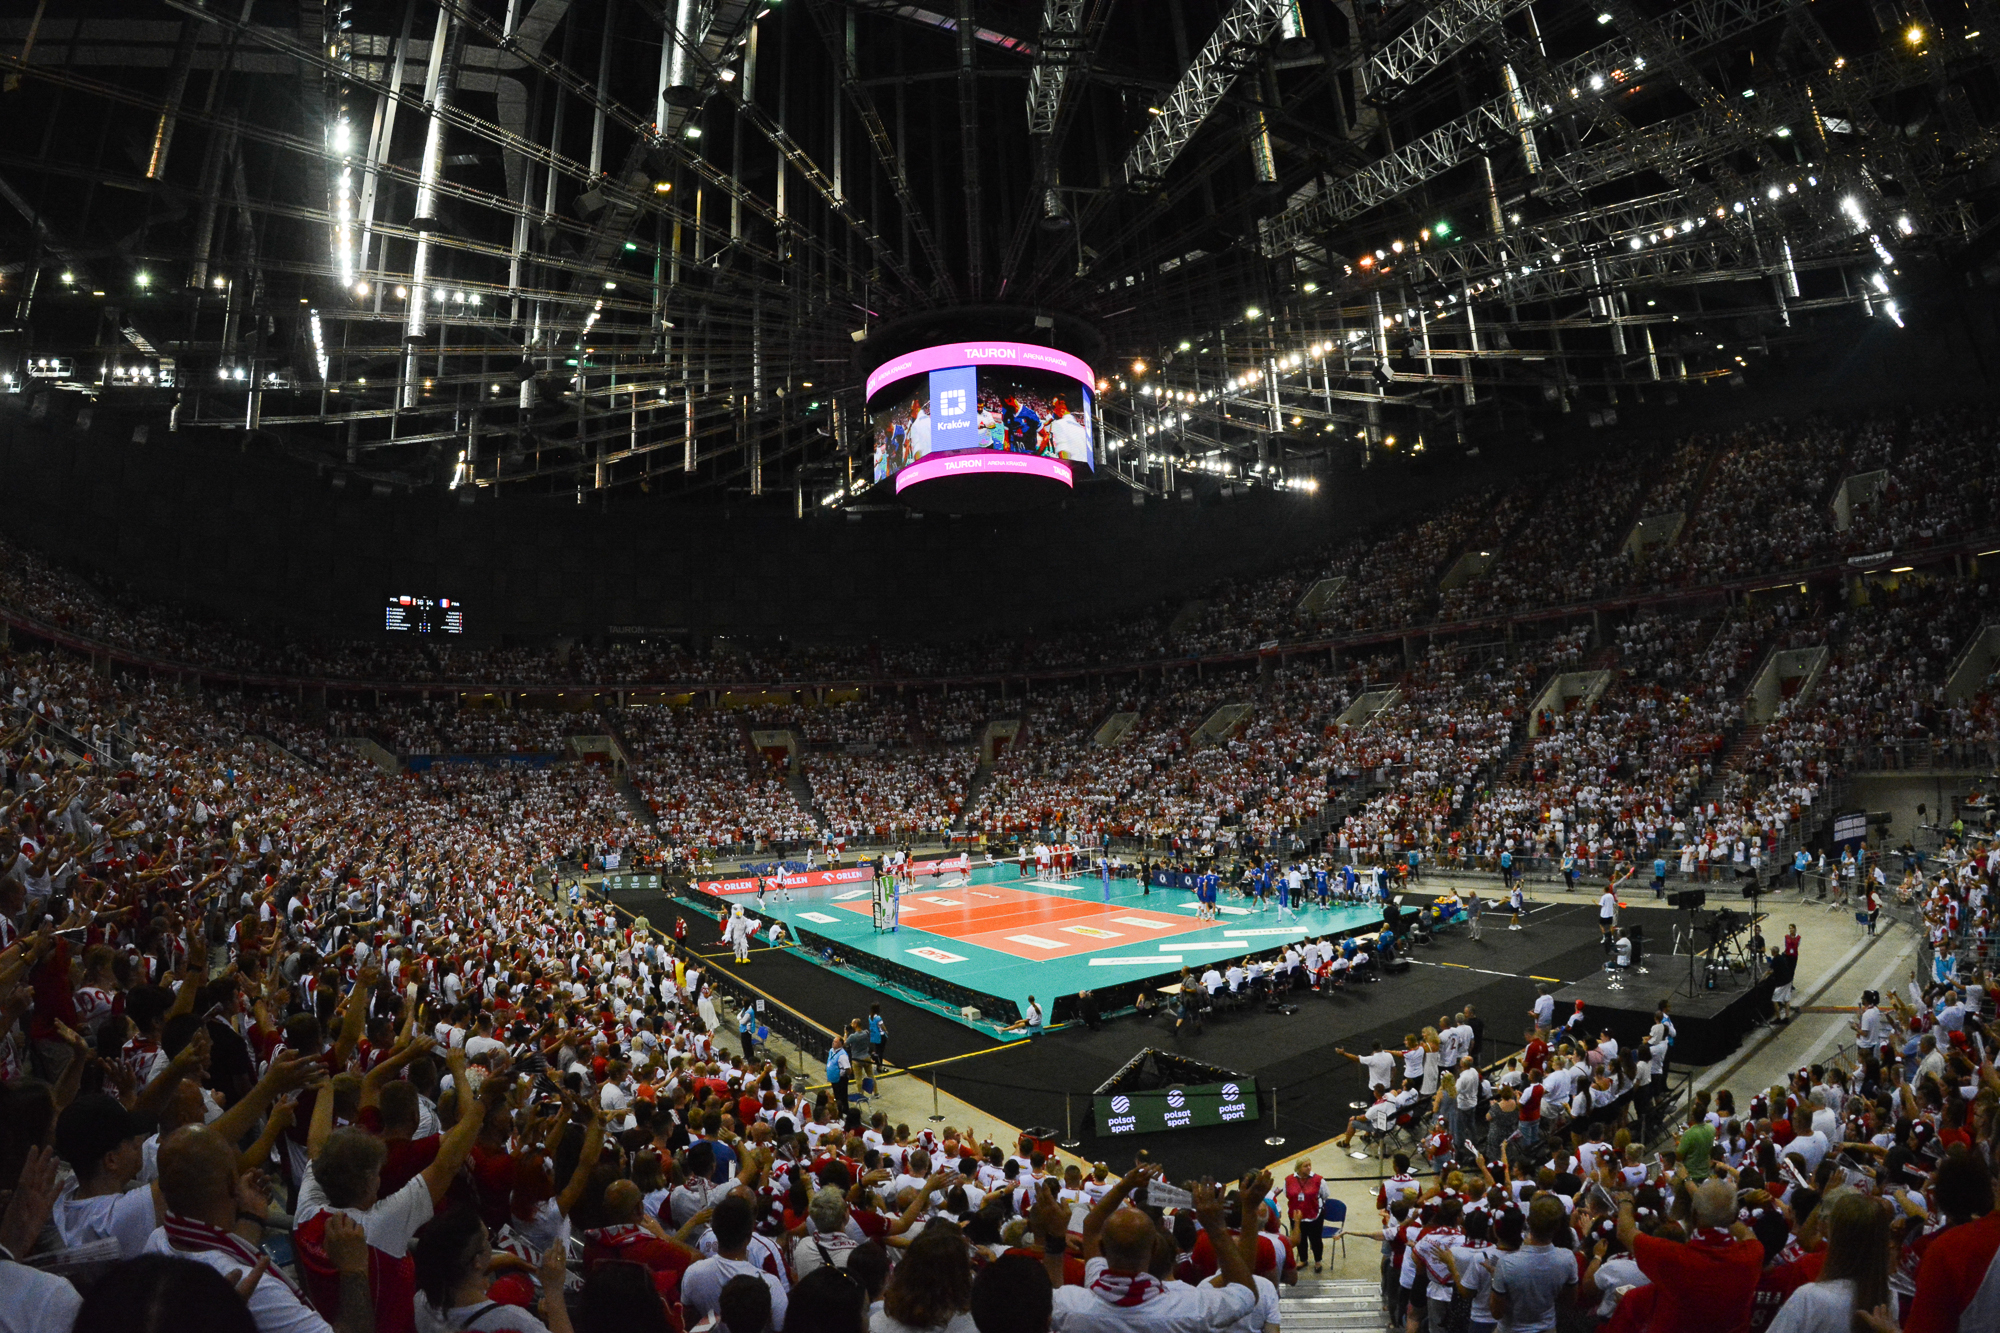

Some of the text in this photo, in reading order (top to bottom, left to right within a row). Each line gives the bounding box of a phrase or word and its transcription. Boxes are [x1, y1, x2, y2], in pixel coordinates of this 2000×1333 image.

[964, 348, 1016, 359] TAURON
[1022, 352, 1067, 367] ARENA KRAKÓW
[937, 419, 970, 431] Kraków
[944, 459, 982, 470] TAURON
[608, 625, 644, 633] TAURON
[836, 870, 863, 880] ORLEN
[723, 881, 752, 891] ORLEN
[1218, 1102, 1246, 1114] polsat
[1164, 1109, 1191, 1120] polsat
[1222, 1110, 1245, 1121] sport
[1108, 1115, 1136, 1126] polsat
[1167, 1117, 1190, 1128] sport
[1111, 1124, 1135, 1133] sport
